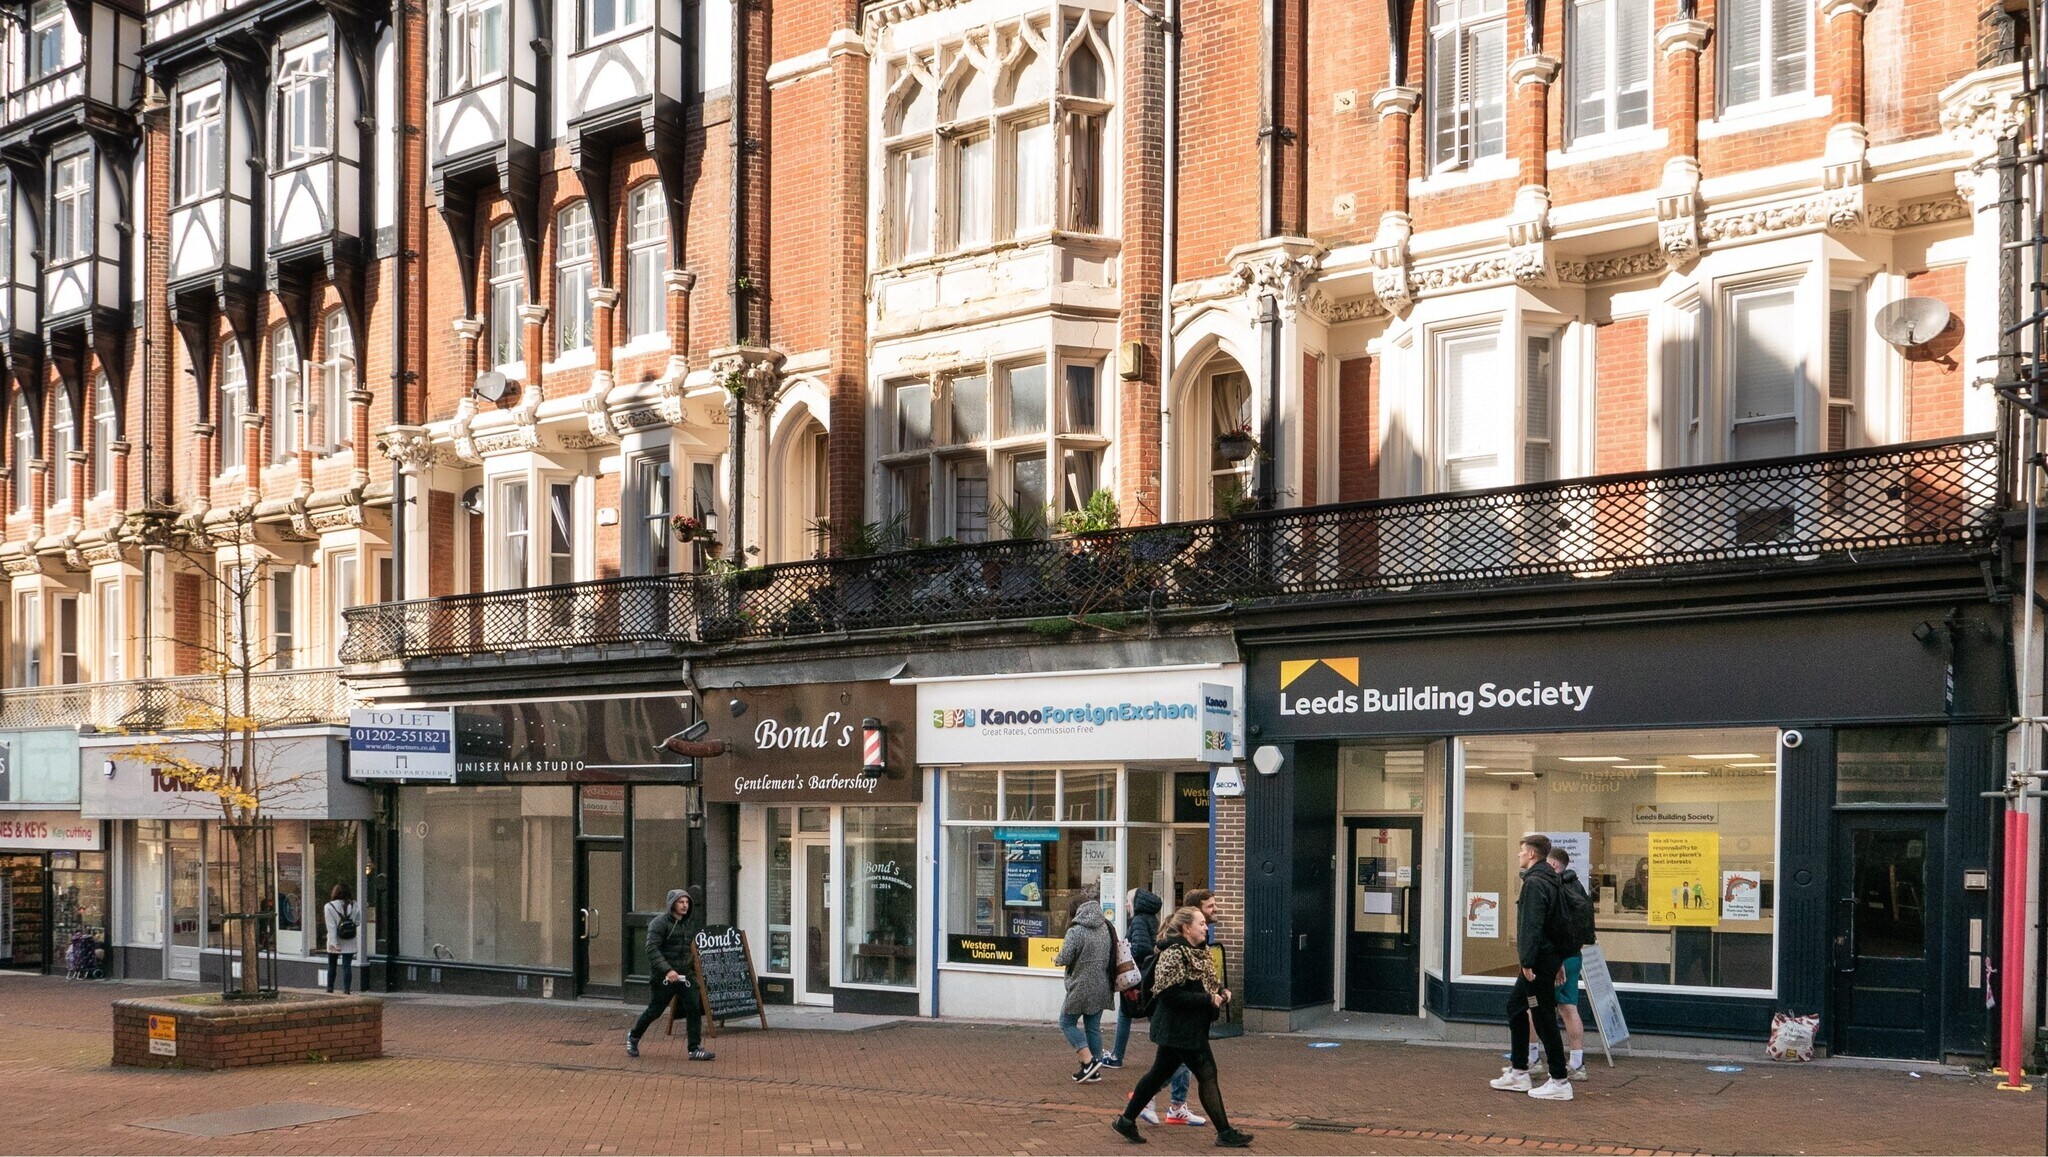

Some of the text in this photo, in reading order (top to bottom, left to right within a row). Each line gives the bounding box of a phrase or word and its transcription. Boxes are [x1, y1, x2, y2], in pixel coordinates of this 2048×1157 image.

[1205, 696, 1228, 708] Kanoo
[1280, 681, 1594, 715] Leeds Building Society
[368, 713, 434, 726] TO LET
[980, 701, 1197, 726] KanooForeignExchan
[355, 729, 447, 742] 01202-551821
[754, 711, 854, 749] Bond's
[982, 725, 1093, 737] Great Rates, Commission Free
[365, 743, 437, 752] www.ellis-partners.co.uk
[457, 761, 584, 772] UNISEX HAIR STUDIO
[734, 773, 877, 794] Gentlemen's Barbershop
[1636, 813, 1715, 822] Leeds Building Society
[15, 821, 22, 838] &
[25, 821, 47, 838] KEYS
[1085, 848, 1105, 859] How
[1013, 918, 1042, 927] CHALLENGE
[1013, 925, 1026, 935] US
[695, 926, 741, 948] Bond's
[961, 940, 996, 950] Western
[1041, 945, 1059, 953] Send
[972, 949, 1013, 960] Union WU
